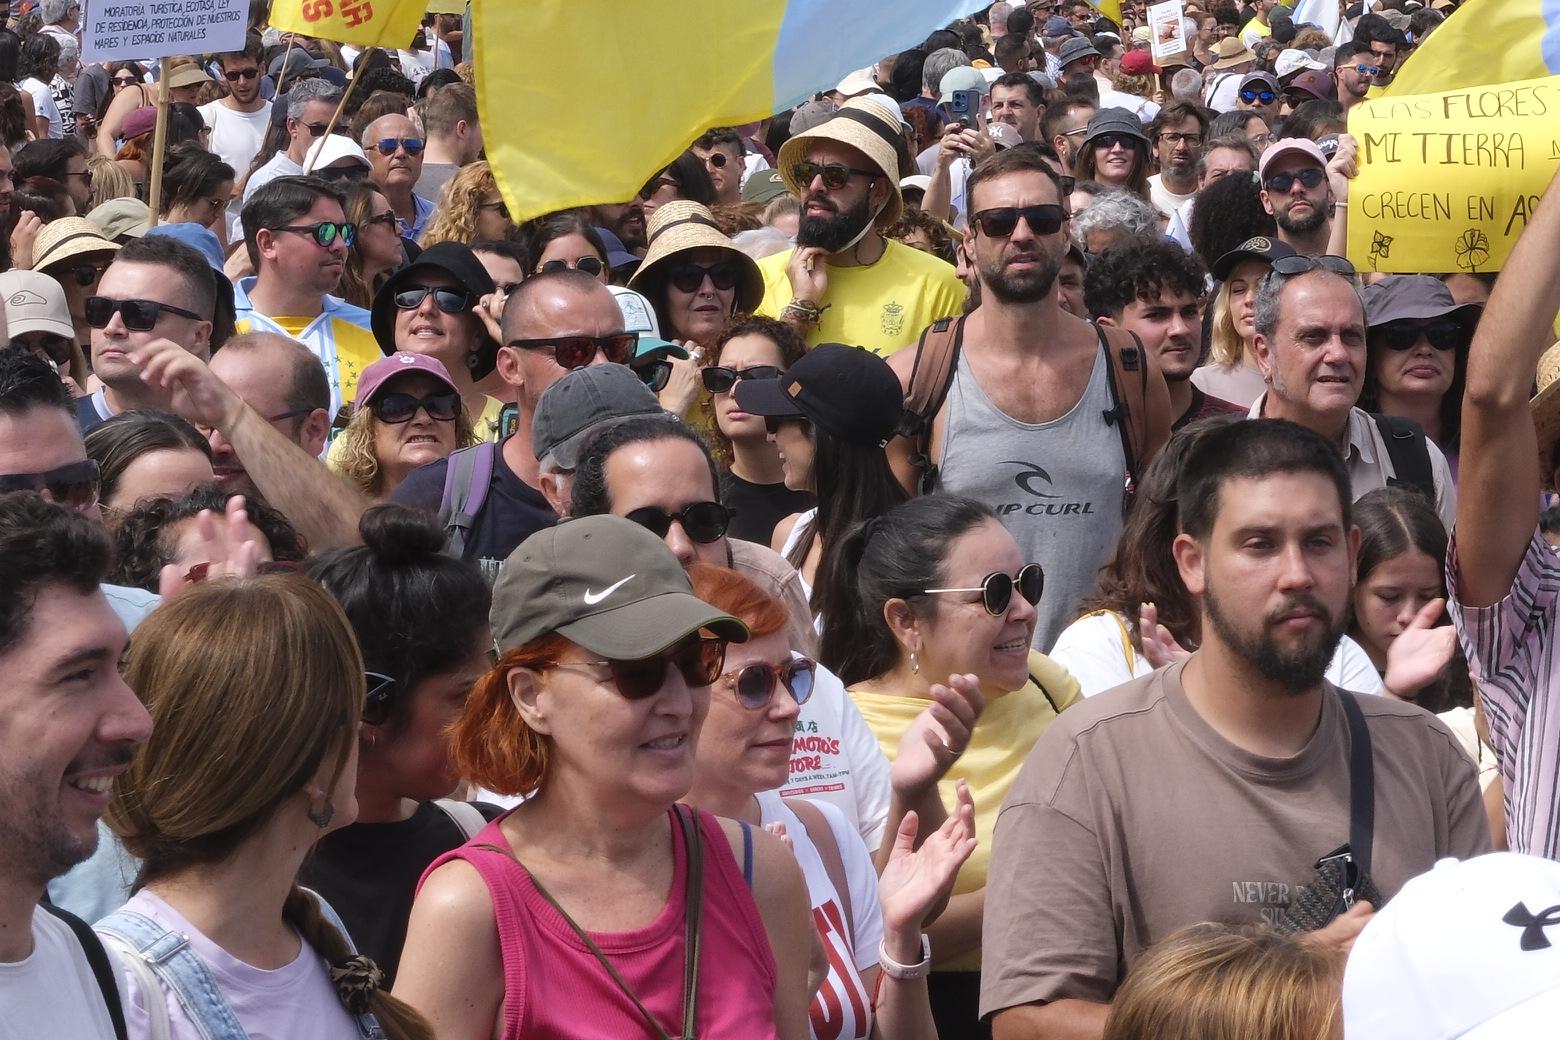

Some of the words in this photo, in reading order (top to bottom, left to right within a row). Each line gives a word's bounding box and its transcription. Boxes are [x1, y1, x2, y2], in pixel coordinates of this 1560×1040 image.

[95, 22, 106, 33] DE
[196, 14, 206, 26] DE
[207, 10, 241, 24] NUESTROS
[94, 35, 119, 49] MARES
[123, 36, 129, 47] Y
[132, 31, 164, 45] ESPACIOS
[168, 27, 206, 42] NATURALES
[1369, 101, 1432, 119] LAS
[1442, 85, 1548, 119] FLORES
[1364, 133, 1402, 165] MI
[1412, 132, 1525, 170] TIERRA
[1362, 191, 1451, 221] CRECEN
[1467, 195, 1494, 221] EN
[1025, 503, 1095, 515] CURL
[790, 735, 840, 755] MOTO'S
[789, 755, 821, 773] TORE
[1232, 882, 1290, 903] NEVER
